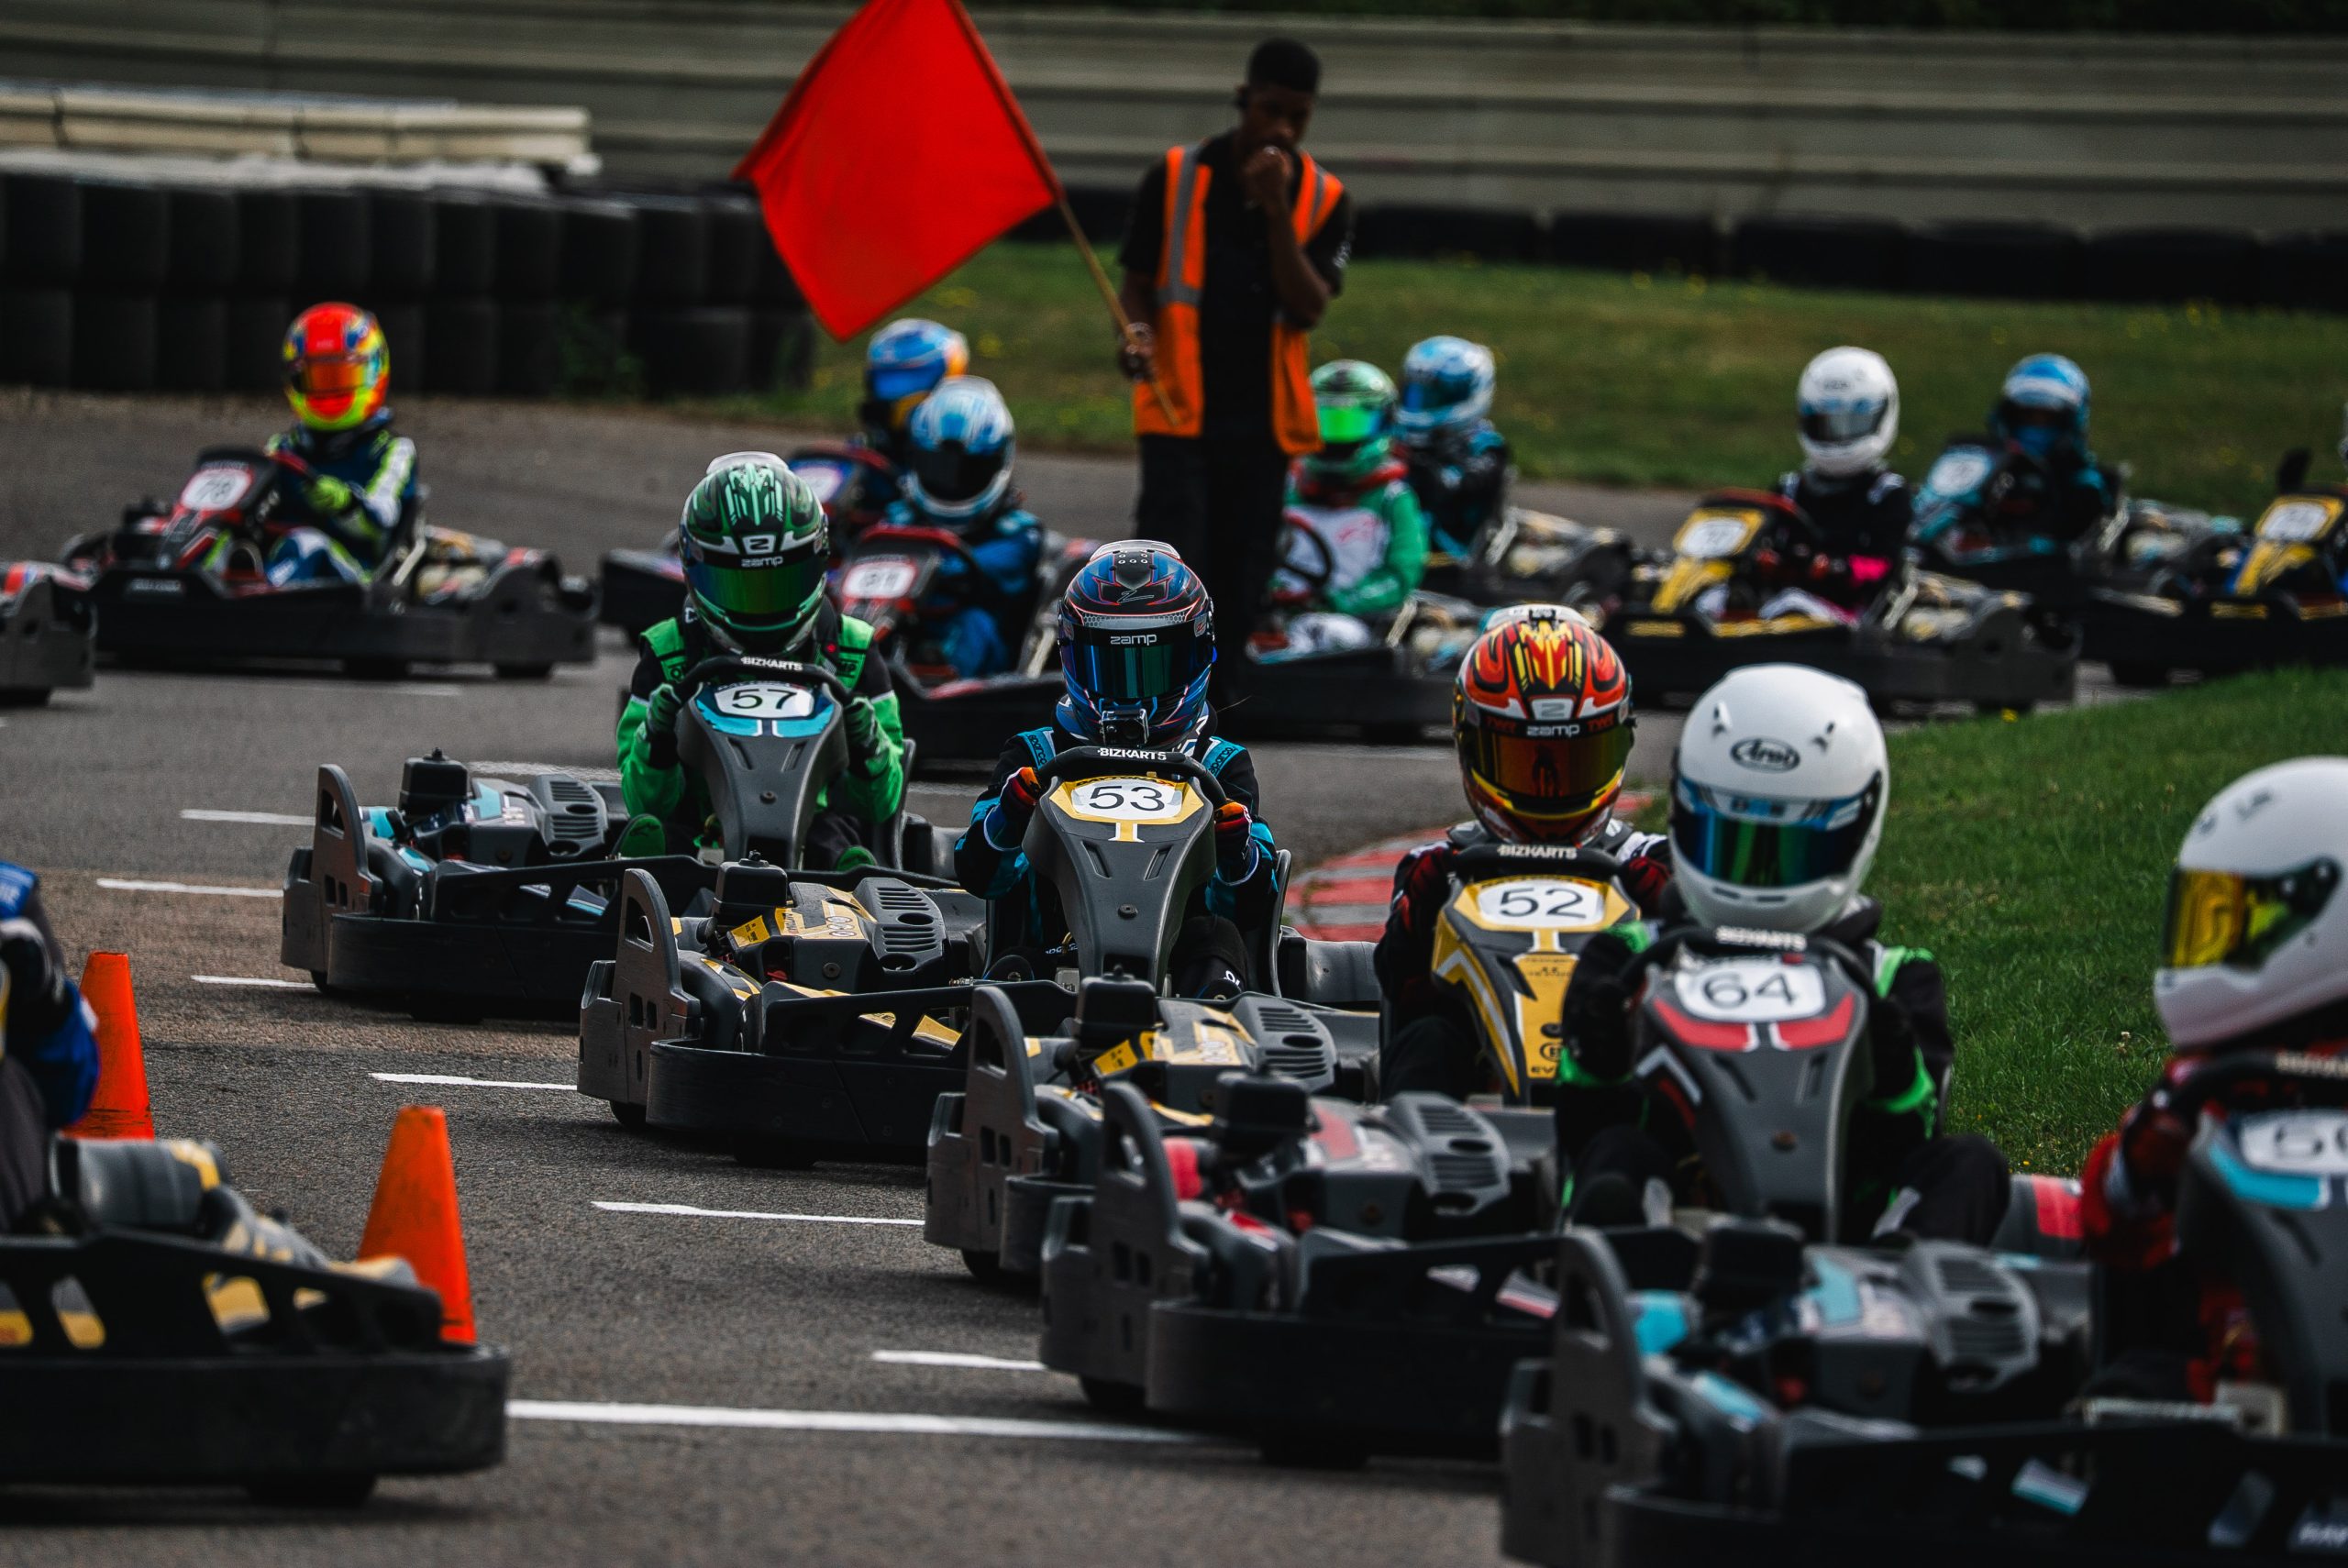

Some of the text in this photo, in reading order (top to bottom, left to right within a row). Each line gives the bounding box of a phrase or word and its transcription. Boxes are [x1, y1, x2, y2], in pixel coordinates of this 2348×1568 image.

[741, 556, 783, 568] zamp
[1110, 634, 1157, 646] zamp
[742, 657, 803, 671] BIZKARTS
[732, 689, 797, 710] 57
[1527, 724, 1580, 737] zamp
[1027, 734, 1047, 765] sparco
[1099, 747, 1167, 760] BIZKARTS
[1089, 786, 1165, 812] 53
[1498, 845, 1578, 860] BIZKARTS
[1499, 887, 1587, 919] 52
[1703, 972, 1799, 1009] 64
